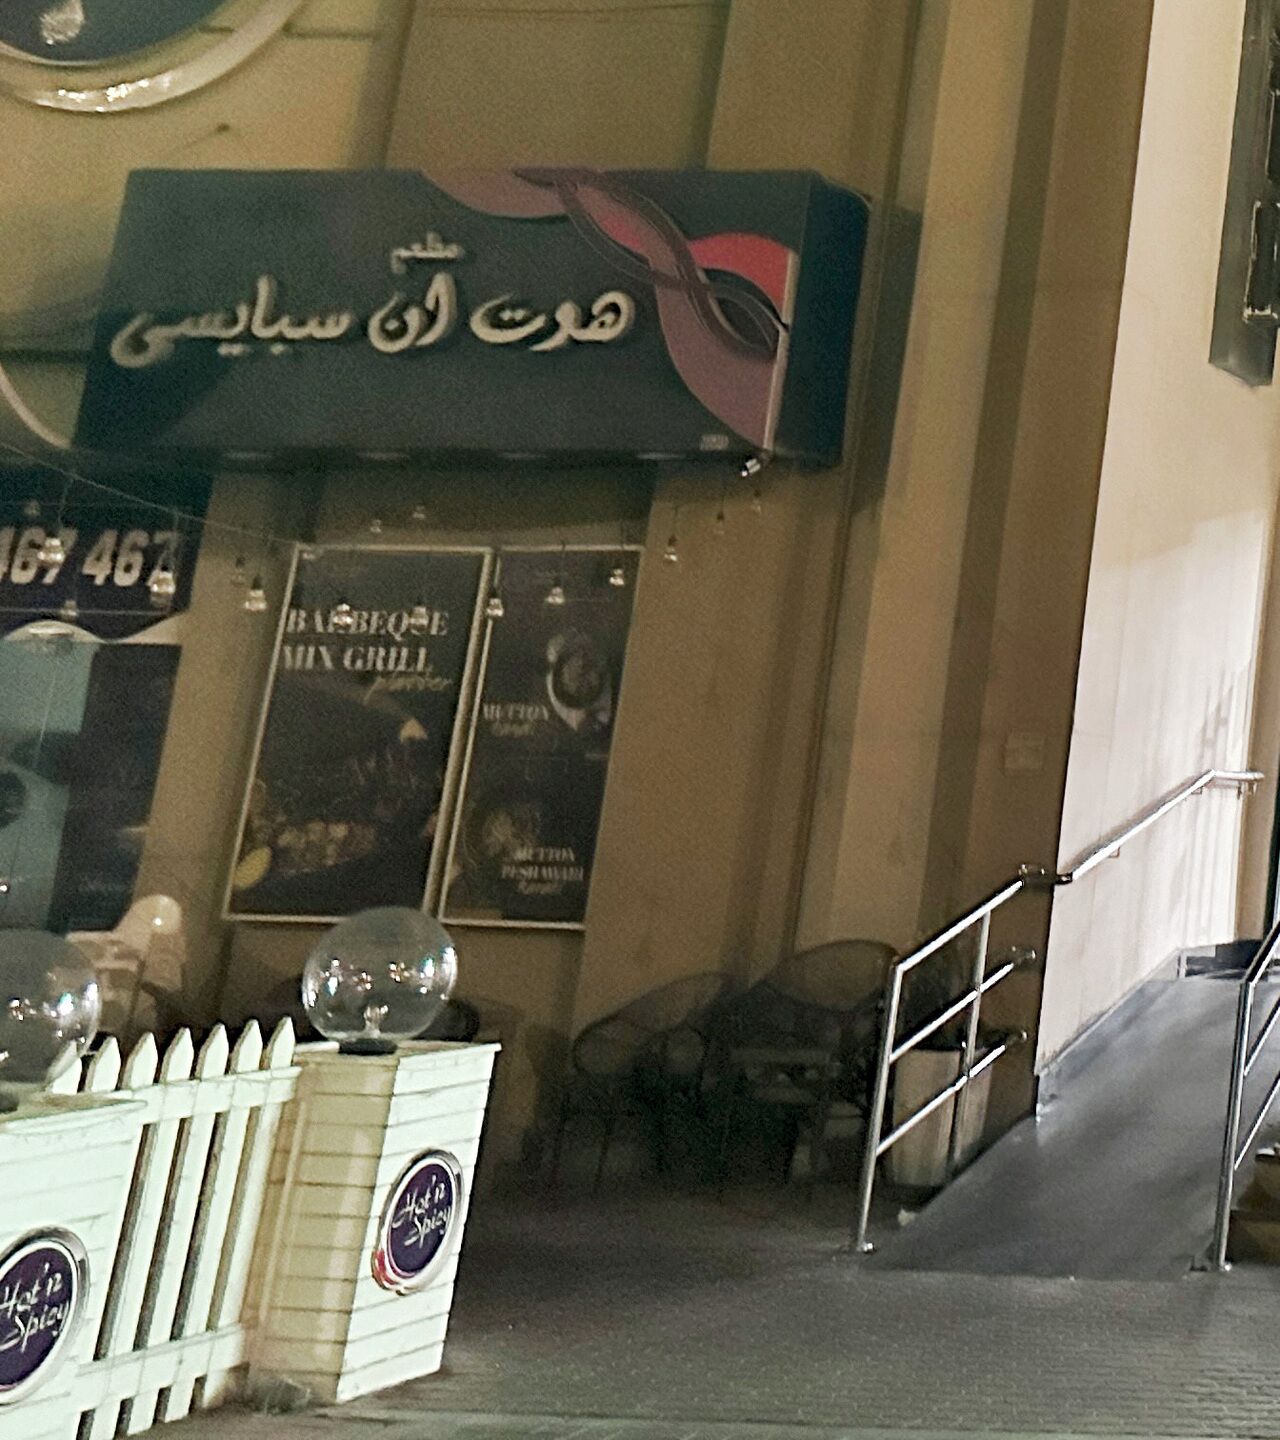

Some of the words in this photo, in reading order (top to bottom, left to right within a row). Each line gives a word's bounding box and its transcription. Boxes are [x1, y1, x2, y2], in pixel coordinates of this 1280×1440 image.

[469, 289, 636, 352] هوت
[82, 528, 181, 587] 467
[283, 645, 336, 671] MIX
[343, 646, 433, 672] GRILL
[391, 1174, 446, 1229] Hot'n
[403, 1206, 452, 1249] Spicy
[0, 1299, 69, 1353] Spicy
